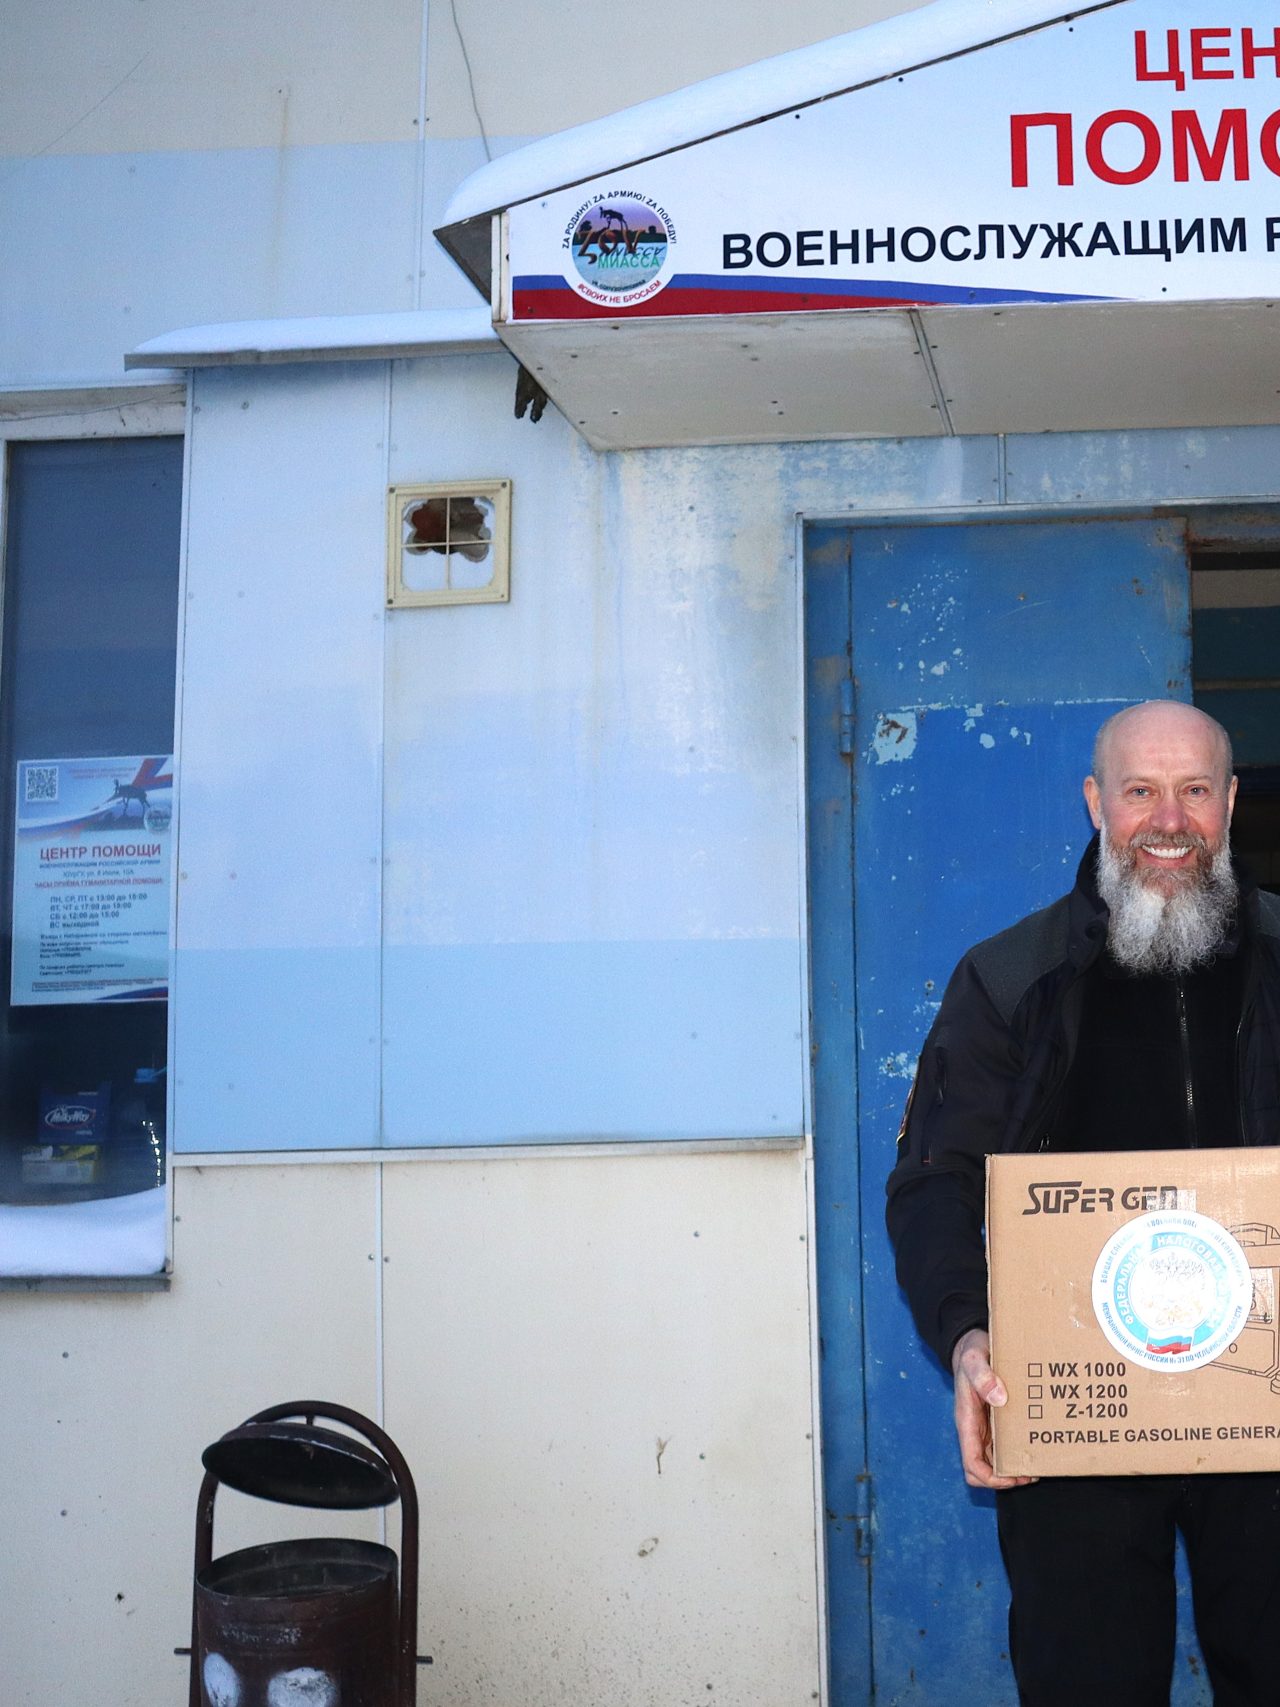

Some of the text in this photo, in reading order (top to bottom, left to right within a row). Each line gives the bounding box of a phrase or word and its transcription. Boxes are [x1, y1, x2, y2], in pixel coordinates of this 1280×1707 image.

[565, 200, 593, 234] РОДИНУ!
[608, 190, 646, 202] АРМИЮ!
[657, 207, 677, 244] ПОБЕДУ!
[723, 217, 1246, 269] ВОЕННОСЛУЖАЩИМ
[598, 255, 660, 268] МИАССА
[623, 280, 661, 303] БРОСАЕМ
[40, 844, 161, 861] ЦЕНТР ПОМОЩИ
[1022, 1181, 1114, 1215] SUPER
[1144, 1352, 1169, 1363] РОССИИ
[1048, 1362, 1126, 1377] WX 1000
[1050, 1384, 1128, 1399] WX 1200
[1065, 1403, 1128, 1418] Z-1200
[1029, 1430, 1119, 1444] PORTABLE
[1124, 1428, 1212, 1443] GASOLINE
